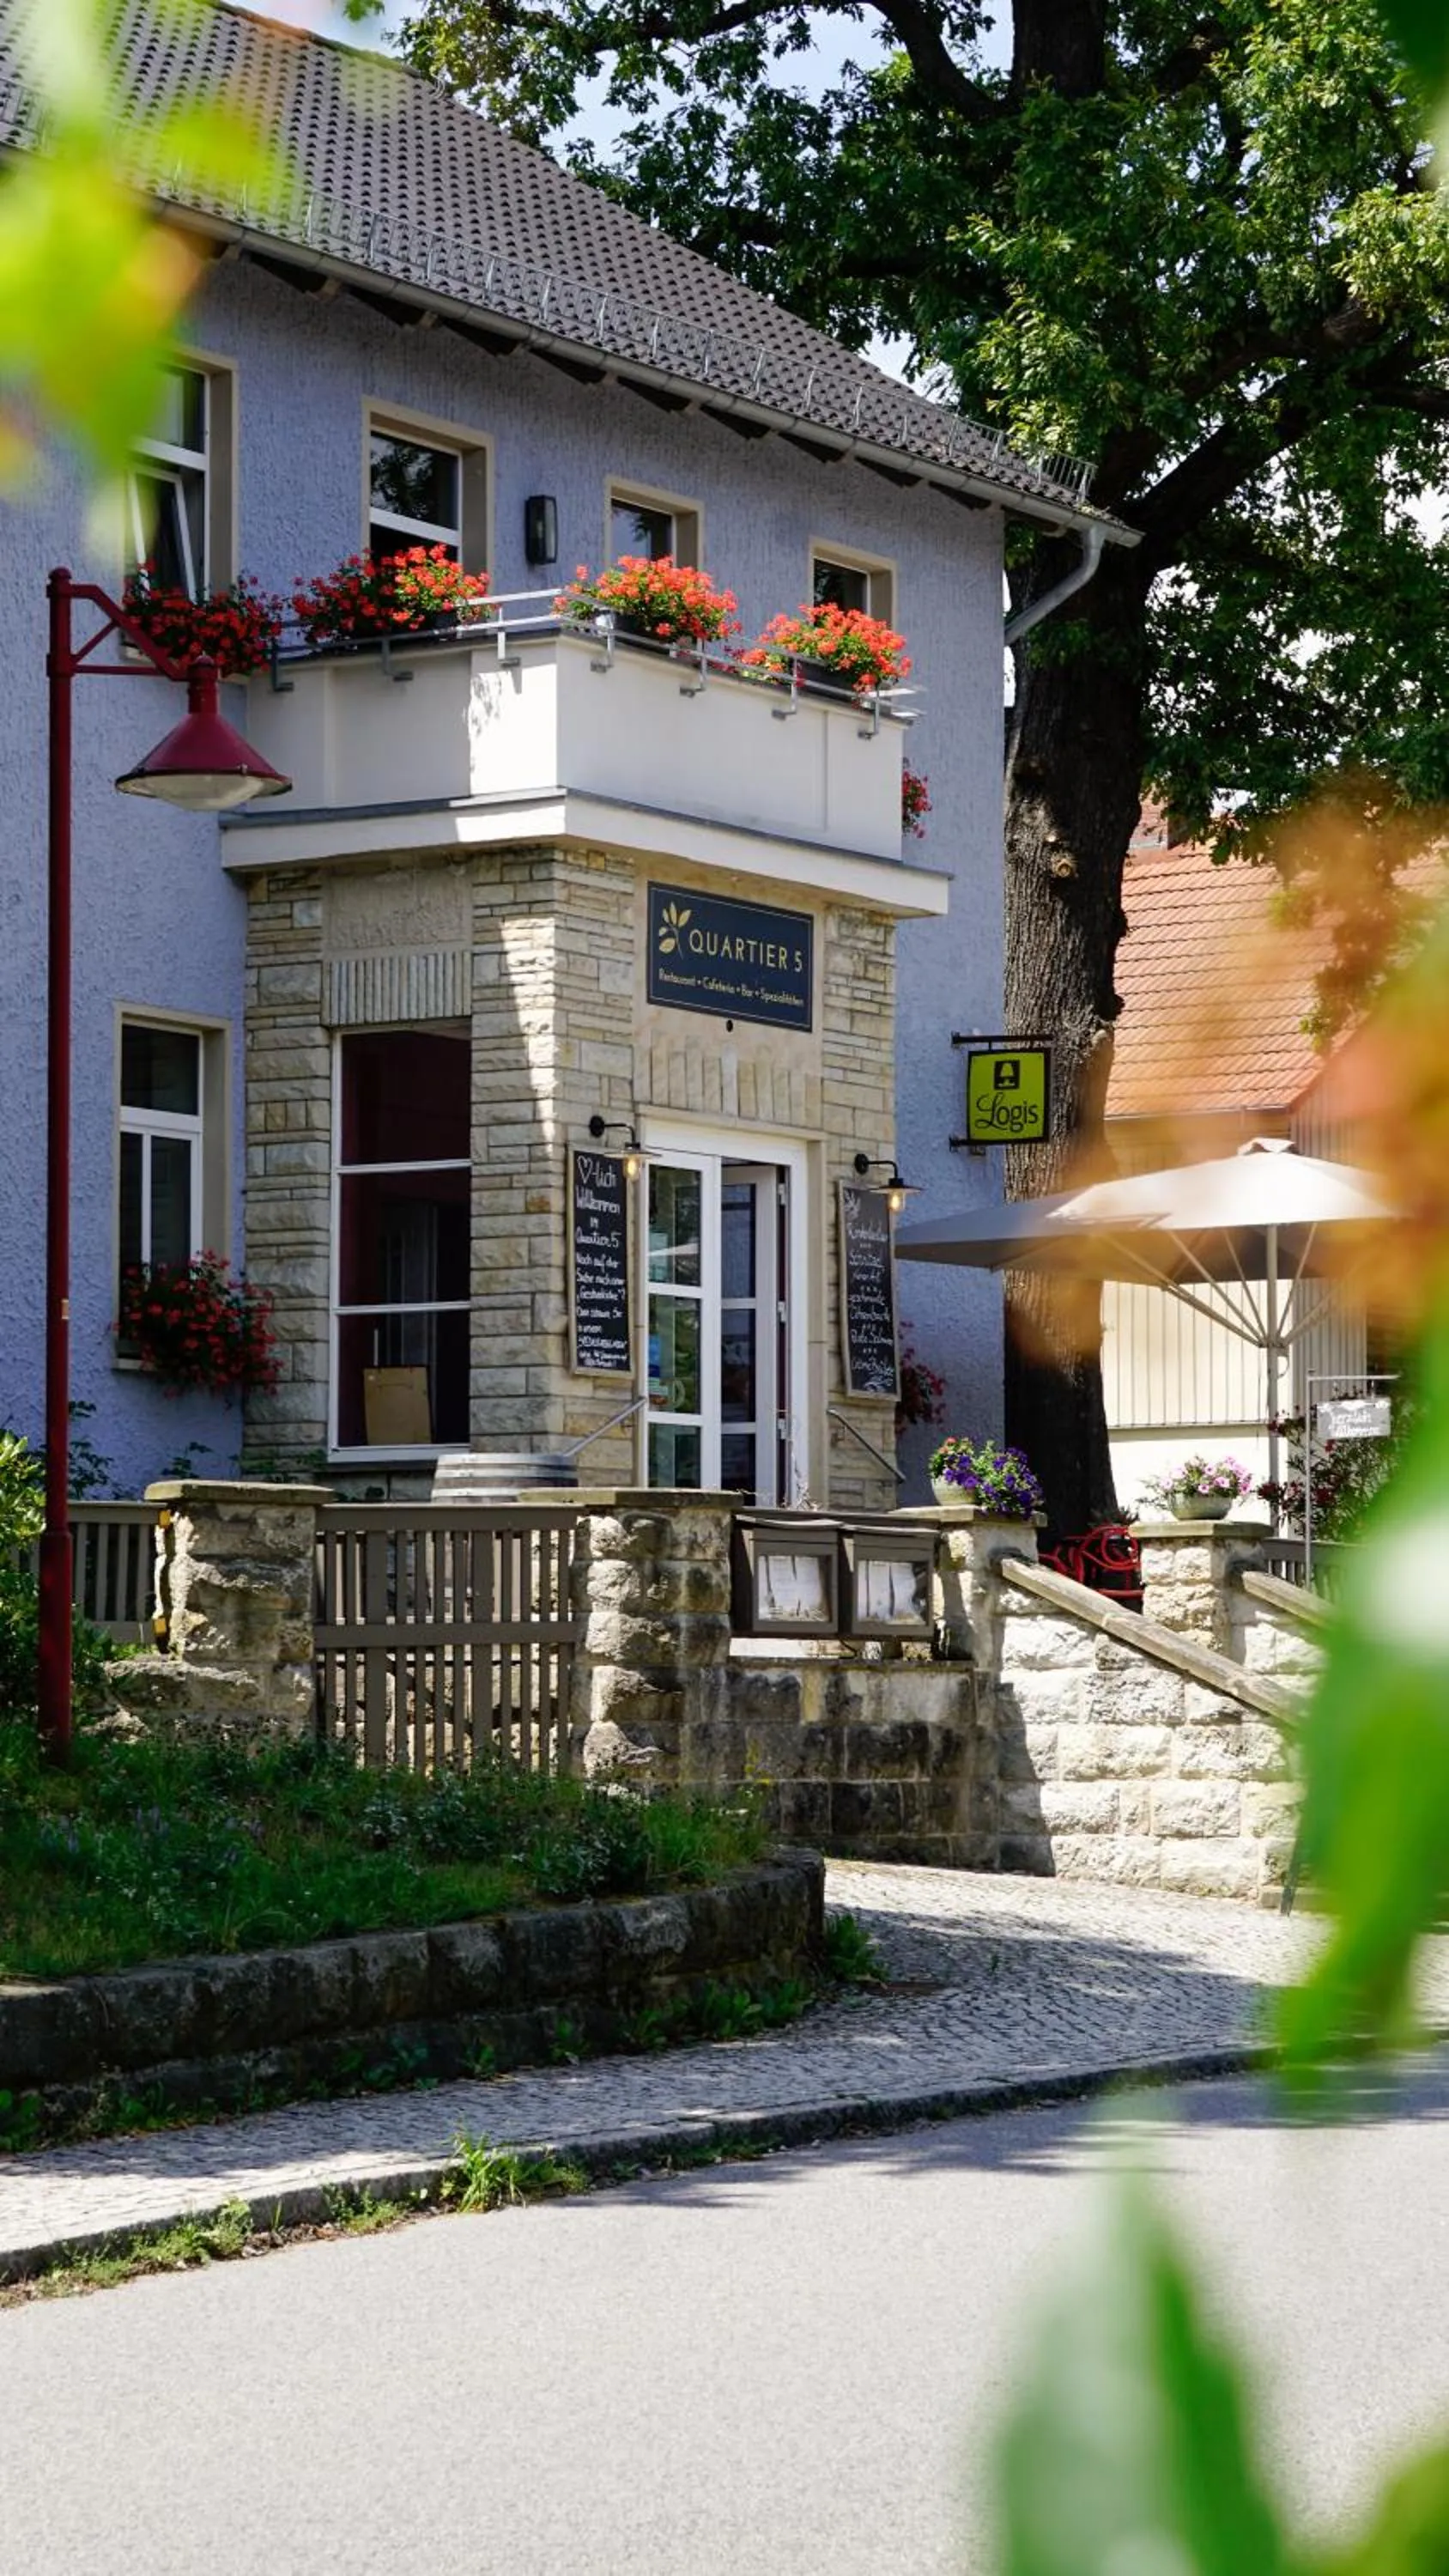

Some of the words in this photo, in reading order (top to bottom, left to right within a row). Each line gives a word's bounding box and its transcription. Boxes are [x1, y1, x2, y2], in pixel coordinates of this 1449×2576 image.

[689, 929, 788, 970] QUARTIER
[794, 951, 803, 973] 5
[658, 968, 696, 987] Restaurant
[702, 976, 735, 994] Cafeteria
[741, 984, 755, 997] Bar
[975, 1091, 1039, 1133] Logis
